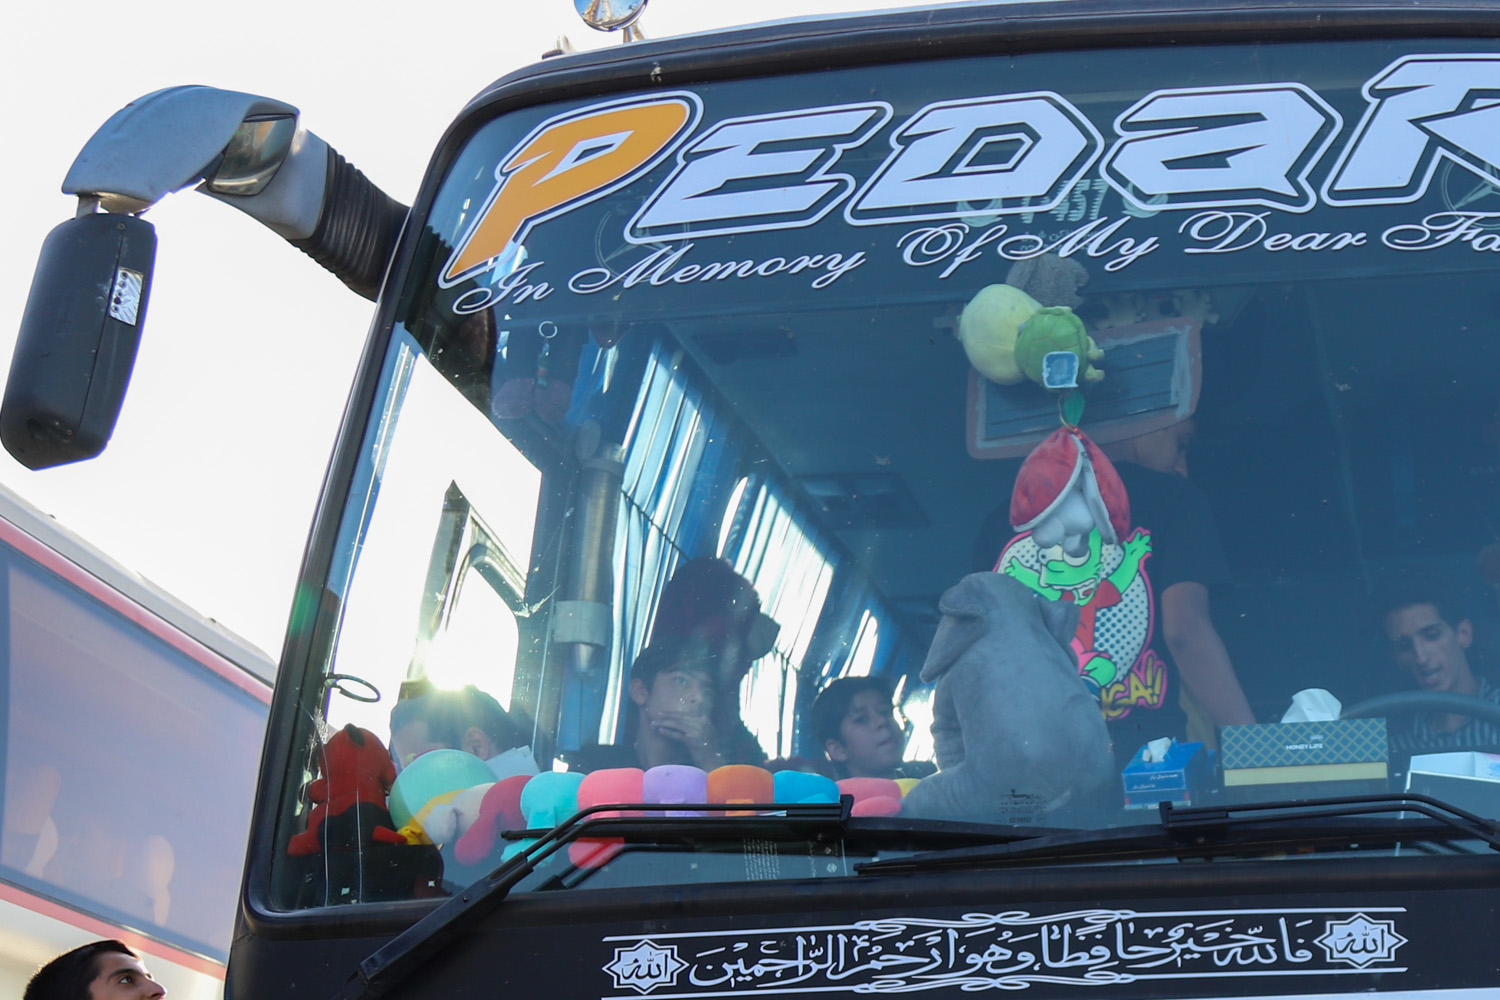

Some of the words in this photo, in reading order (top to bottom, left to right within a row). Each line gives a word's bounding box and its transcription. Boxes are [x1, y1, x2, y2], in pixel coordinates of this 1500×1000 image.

[452, 260, 555, 316] In
[568, 242, 866, 294] Memory
[896, 222, 1008, 279] Of
[997, 214, 1160, 273] My
[1178, 210, 1368, 254] Dear
